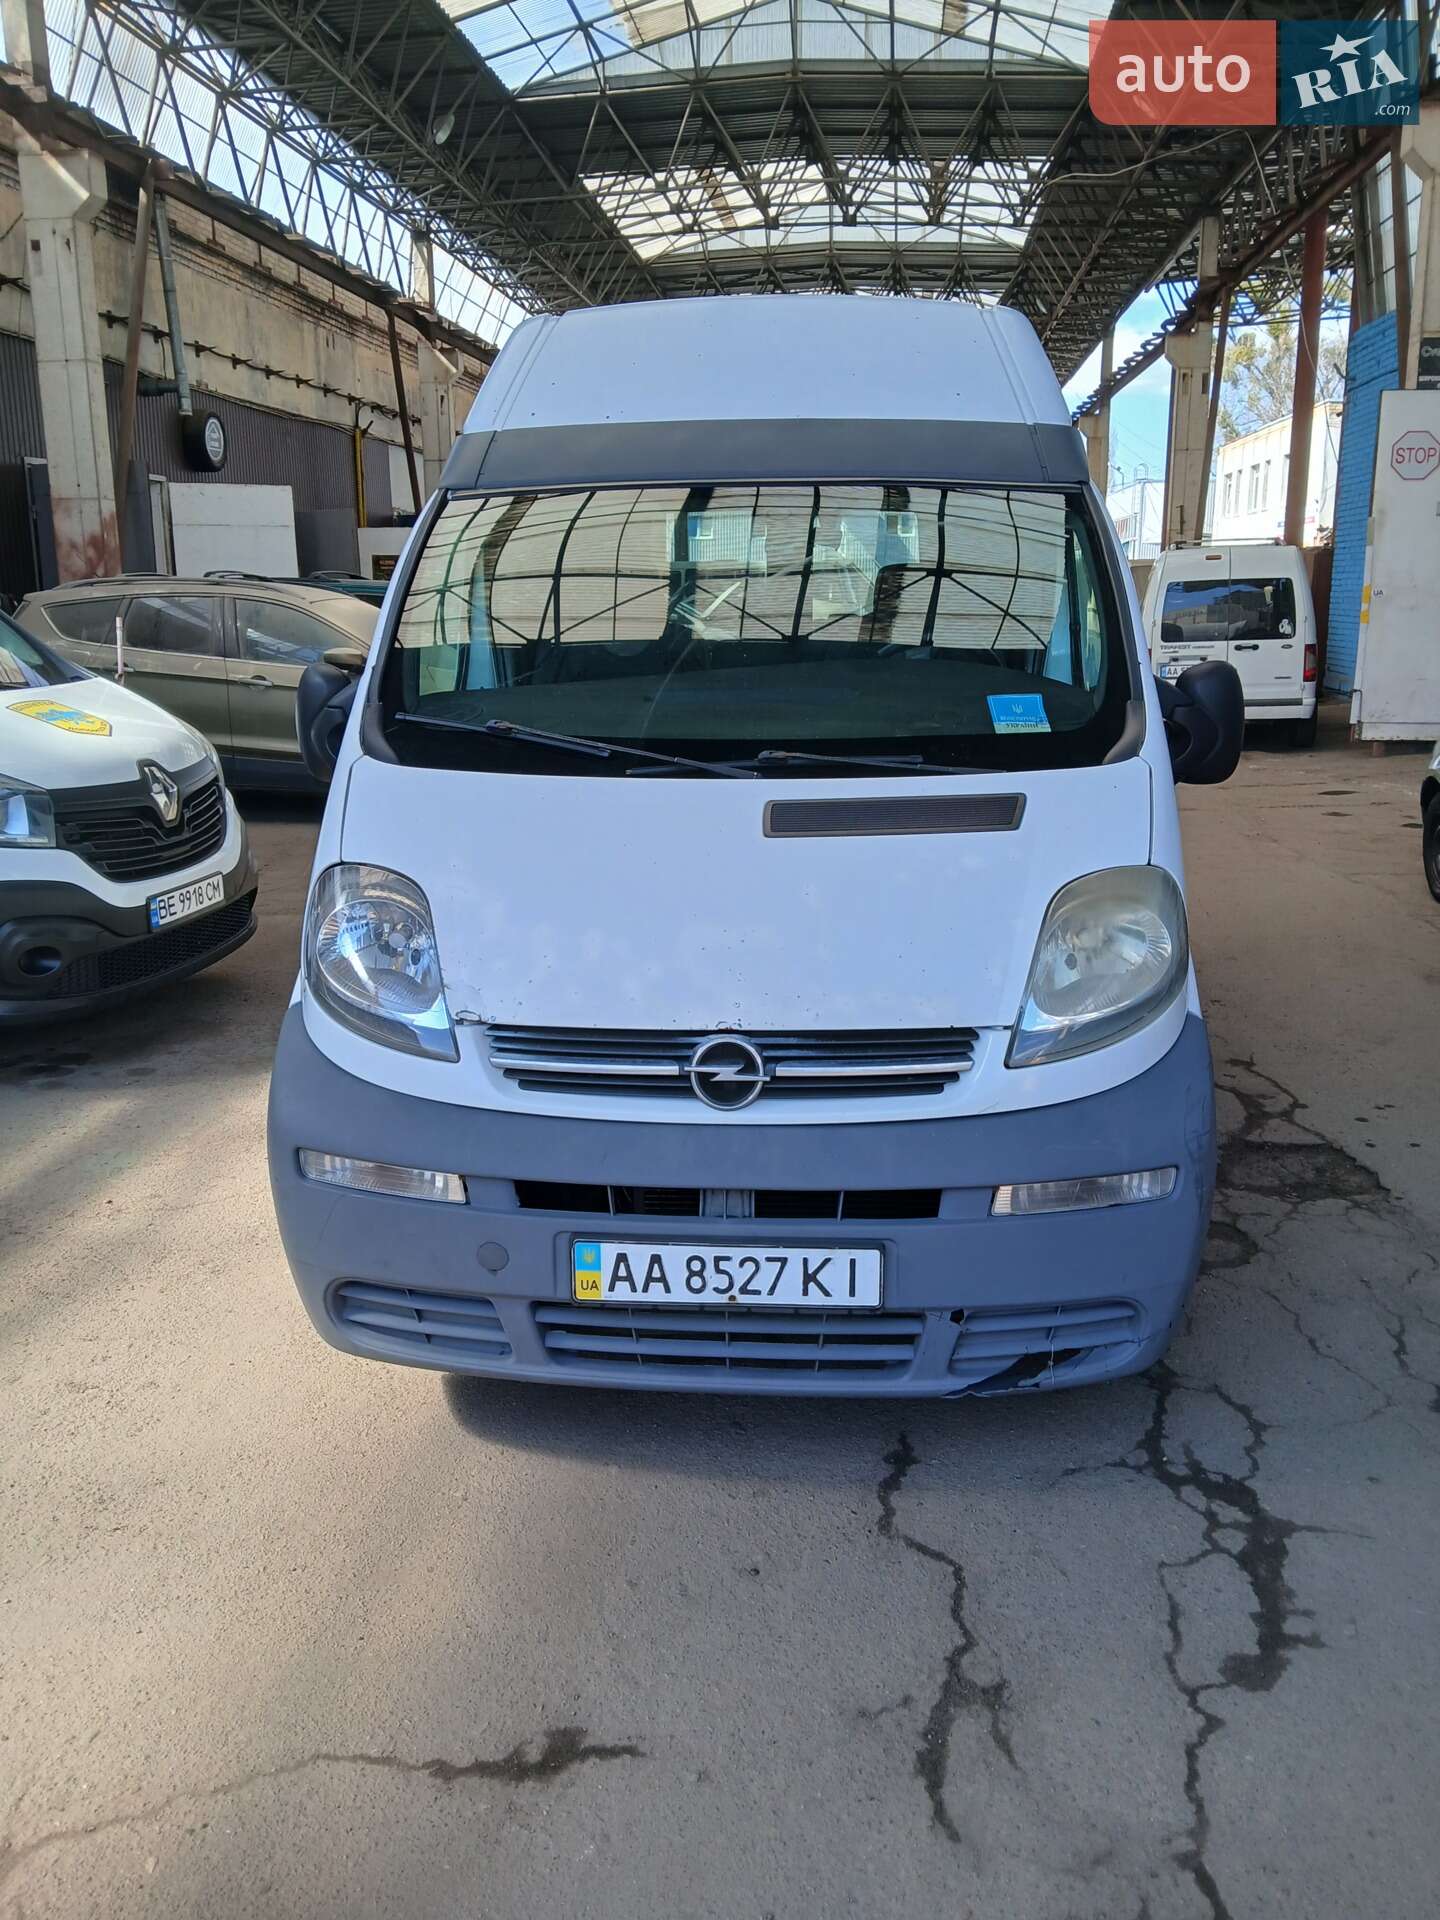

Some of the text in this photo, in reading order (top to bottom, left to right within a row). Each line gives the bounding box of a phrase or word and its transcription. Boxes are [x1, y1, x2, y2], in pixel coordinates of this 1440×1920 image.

[1395, 447, 1437, 465] STOP
[158, 895, 177, 920] BE
[179, 886, 203, 912] 9918
[206, 880, 220, 901] CM
[580, 1279, 600, 1291] UA
[607, 1251, 857, 1298] AA 8527 KI
